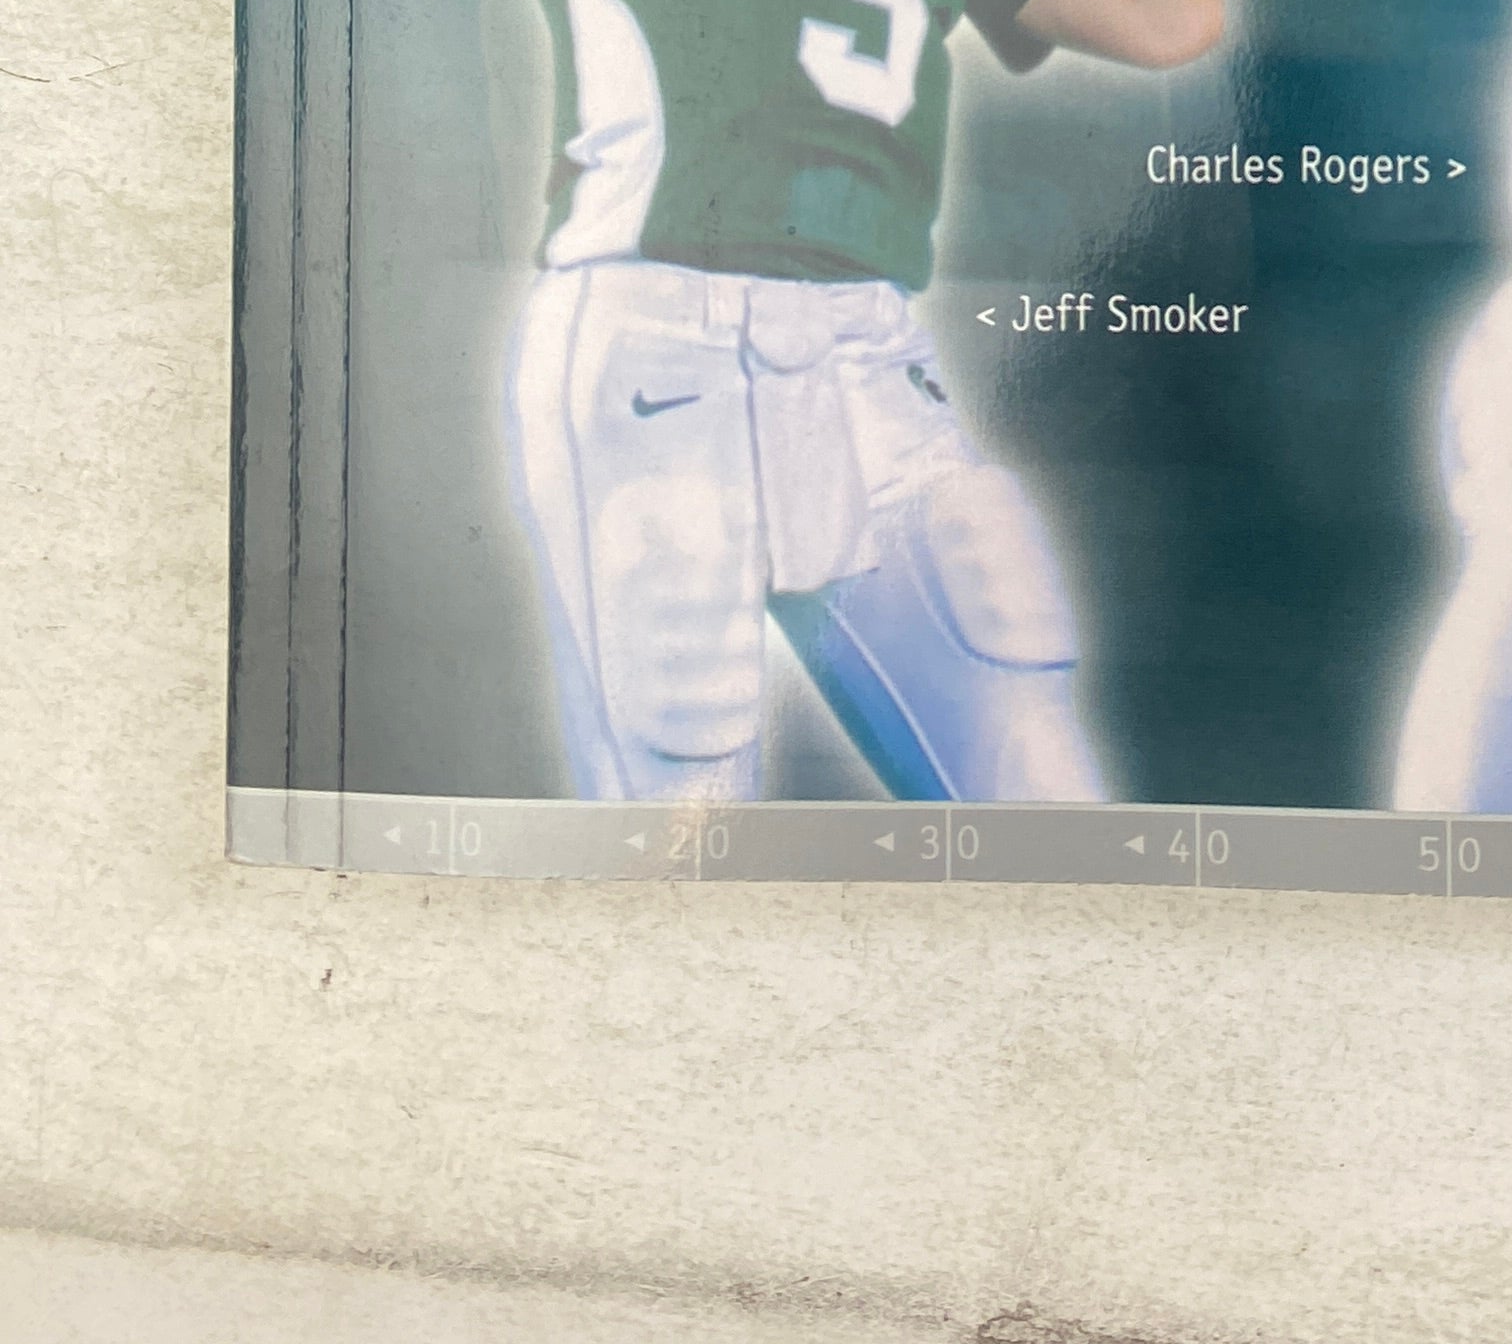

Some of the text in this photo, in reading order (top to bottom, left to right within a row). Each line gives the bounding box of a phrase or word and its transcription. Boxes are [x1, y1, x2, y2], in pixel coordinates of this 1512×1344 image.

[1146, 144, 1284, 184] Charles
[1301, 146, 1431, 193] Rogers
[1012, 293, 1095, 333] Jeff
[1108, 293, 1249, 333] Smoker
[425, 819, 482, 858] 10
[919, 824, 980, 861] 30
[1166, 829, 1231, 866] 40
[1417, 836, 1482, 874] 50
